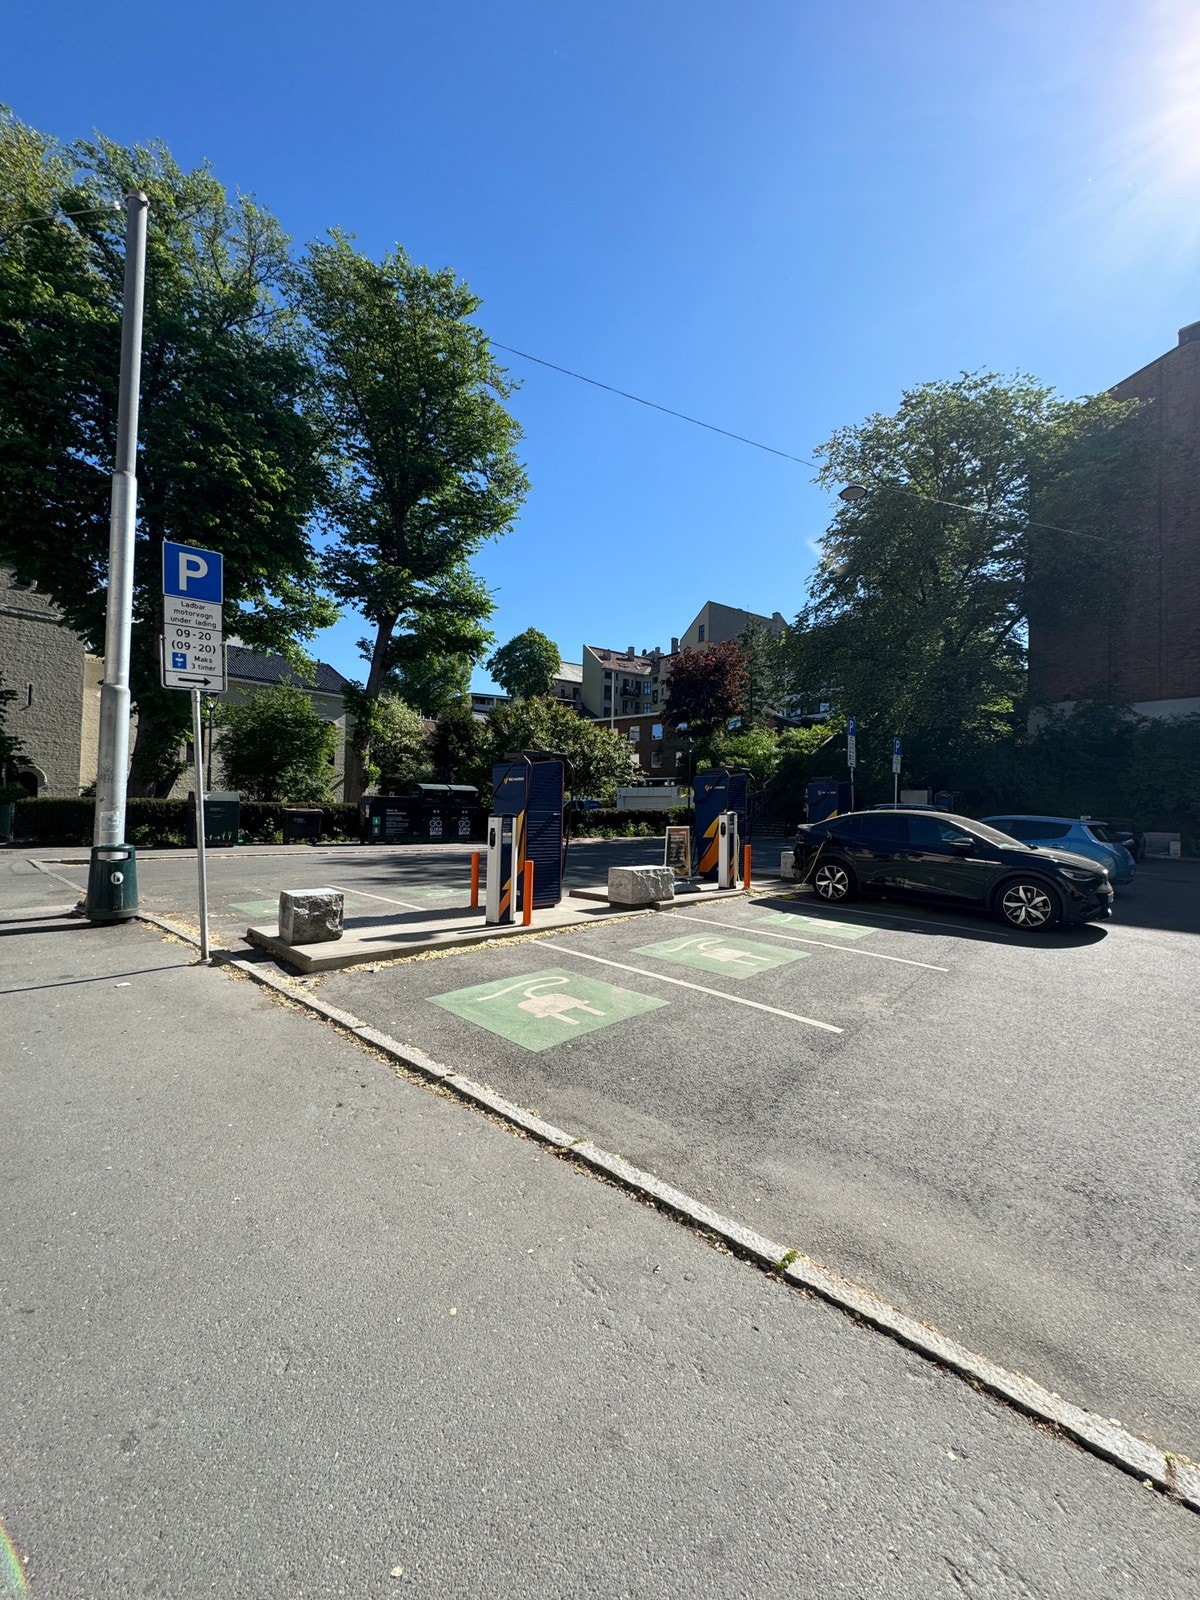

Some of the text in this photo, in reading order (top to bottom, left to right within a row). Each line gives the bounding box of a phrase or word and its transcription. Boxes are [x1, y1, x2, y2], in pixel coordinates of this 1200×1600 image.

[178, 552, 209, 591] P
[180, 600, 206, 610] Ladbar
[173, 608, 214, 620] motorvogn
[170, 616, 217, 629] under lading
[194, 655, 213, 664] Maks
[198, 664, 217, 672] timer
[849, 720, 854, 733] P
[895, 740, 900, 753] P
